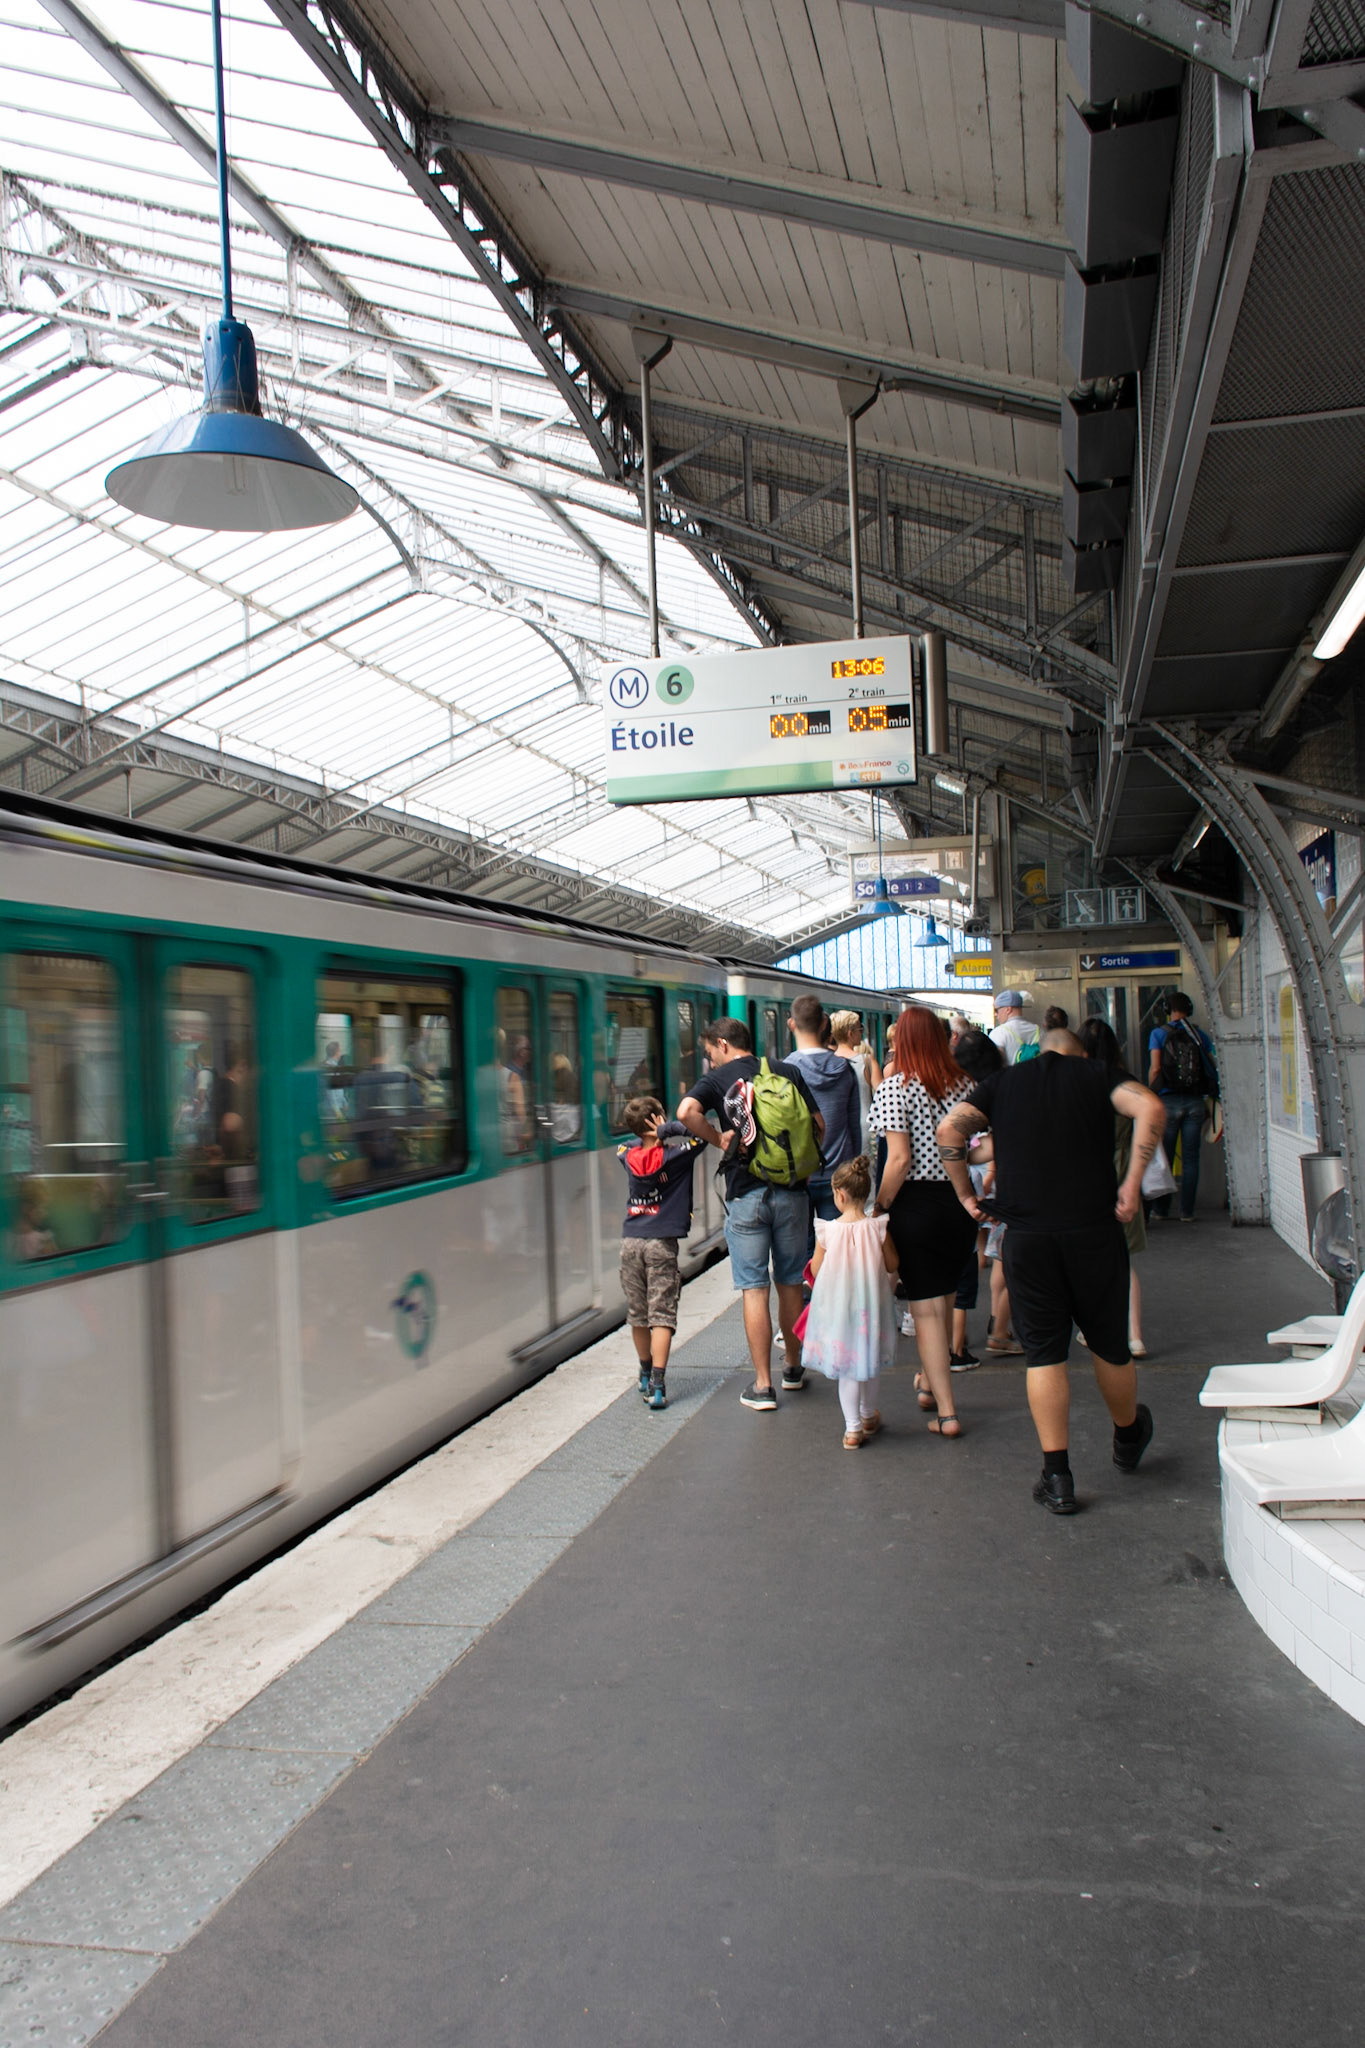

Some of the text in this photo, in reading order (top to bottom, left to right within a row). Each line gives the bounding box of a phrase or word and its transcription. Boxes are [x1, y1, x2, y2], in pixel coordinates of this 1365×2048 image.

[833, 656, 885, 678] 13:06
[618, 672, 683, 699] M 6
[862, 687, 886, 697] train
[785, 694, 808, 704] train
[771, 712, 830, 738] 00 min
[849, 705, 910, 732] 05 min
[611, 721, 694, 751] Étoile
[856, 882, 899, 896] Soie
[1101, 956, 1130, 966] Sortie
